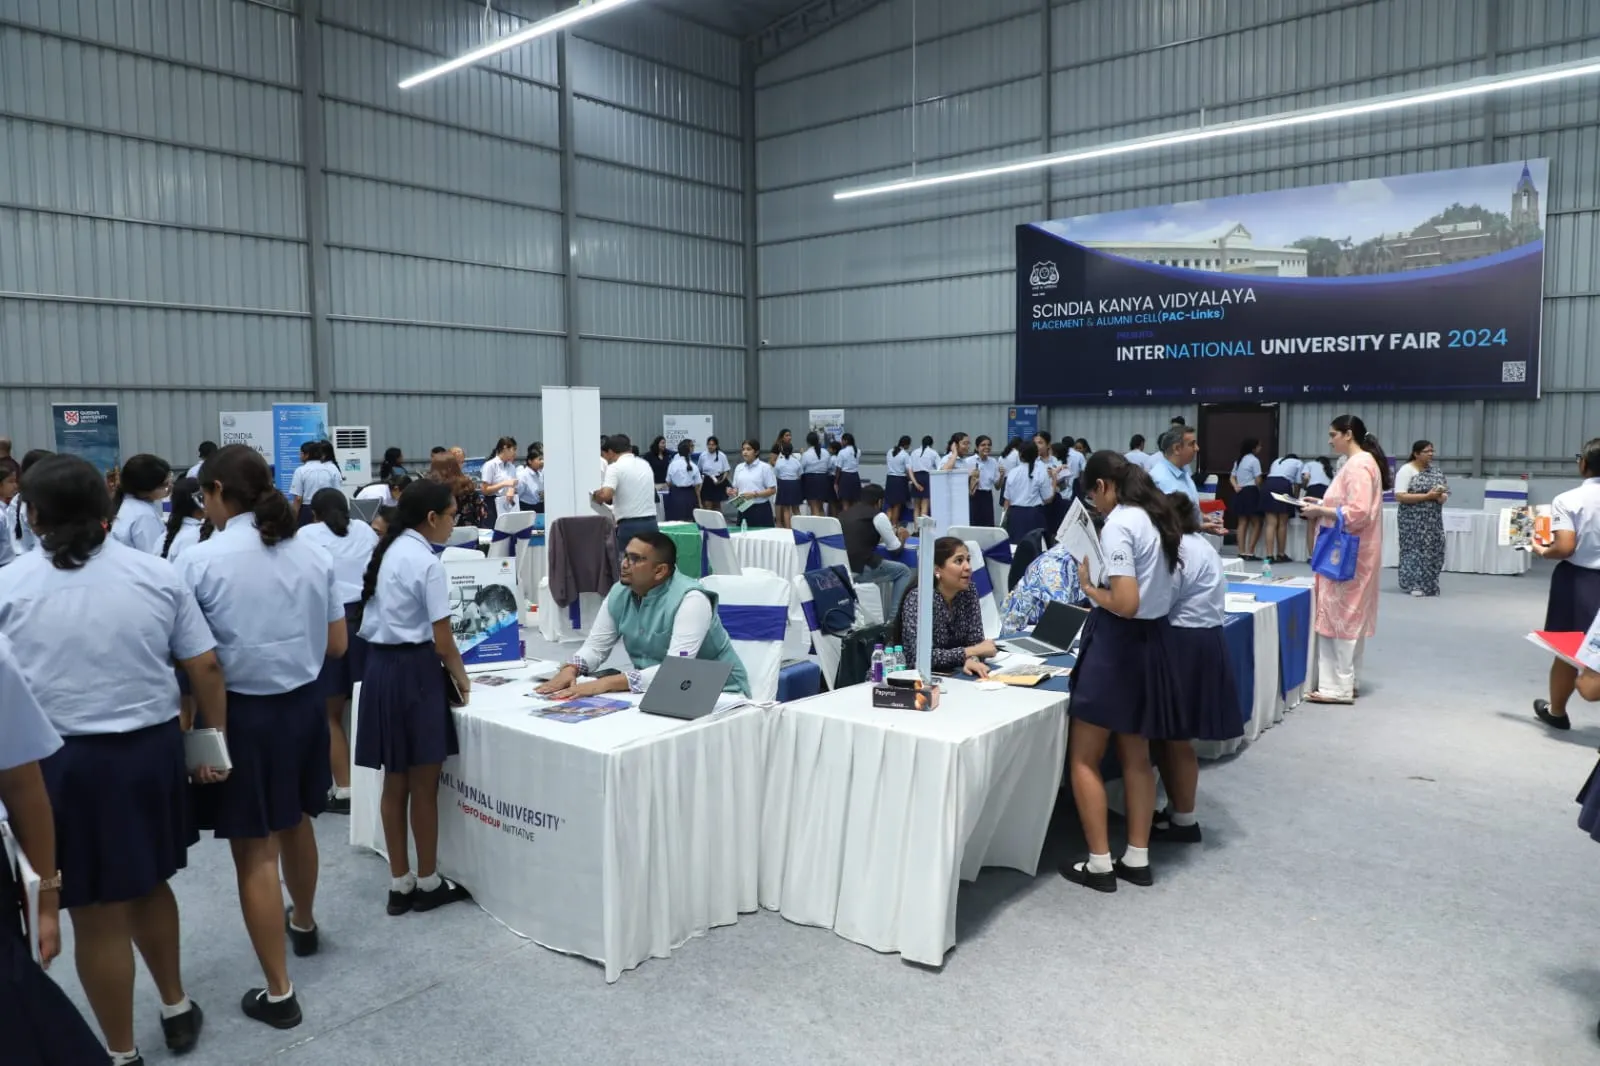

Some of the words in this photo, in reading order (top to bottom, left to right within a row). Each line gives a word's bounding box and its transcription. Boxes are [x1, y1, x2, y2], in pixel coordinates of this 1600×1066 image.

[1032, 300, 1094, 319] SCINDIA
[1099, 296, 1154, 314] KANYA
[1158, 287, 1257, 309] VIDYALAYA
[1032, 319, 1084, 331] PLACEMENT
[1087, 318, 1094, 327] &
[1096, 315, 1133, 327] ALUMNI
[1116, 340, 1255, 361] INTERNATIONAL
[1261, 334, 1385, 355] UNIVERSITY
[1390, 331, 1441, 350] FAIR
[1448, 327, 1509, 349] 2024
[223, 432, 253, 440] SCINDIA
[496, 799, 560, 832] UNIVERSITY
[502, 822, 536, 842] INITIATIVE
